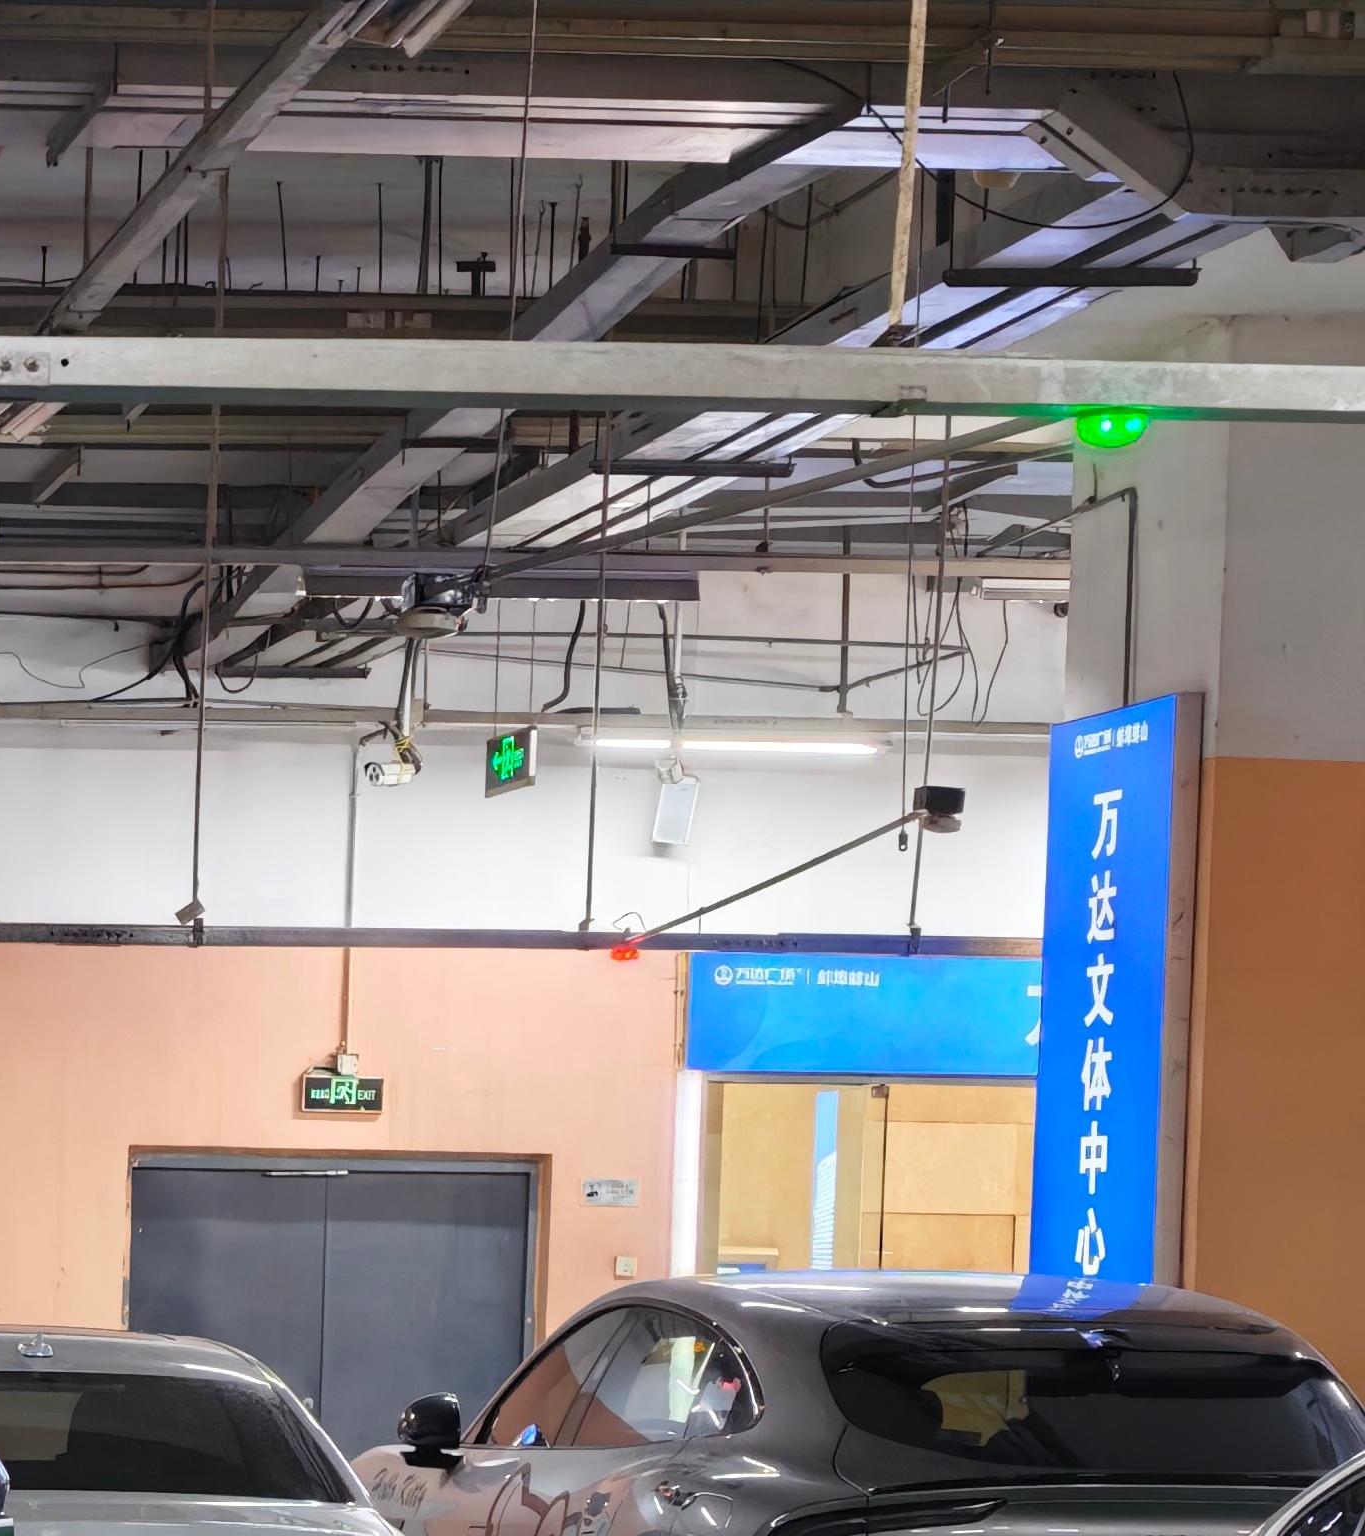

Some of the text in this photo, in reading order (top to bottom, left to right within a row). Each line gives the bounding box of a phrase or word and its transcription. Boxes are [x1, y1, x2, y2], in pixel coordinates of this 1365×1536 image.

[358, 1089, 377, 1101] EXIT
[1074, 788, 1123, 1276] 万达文体中心
